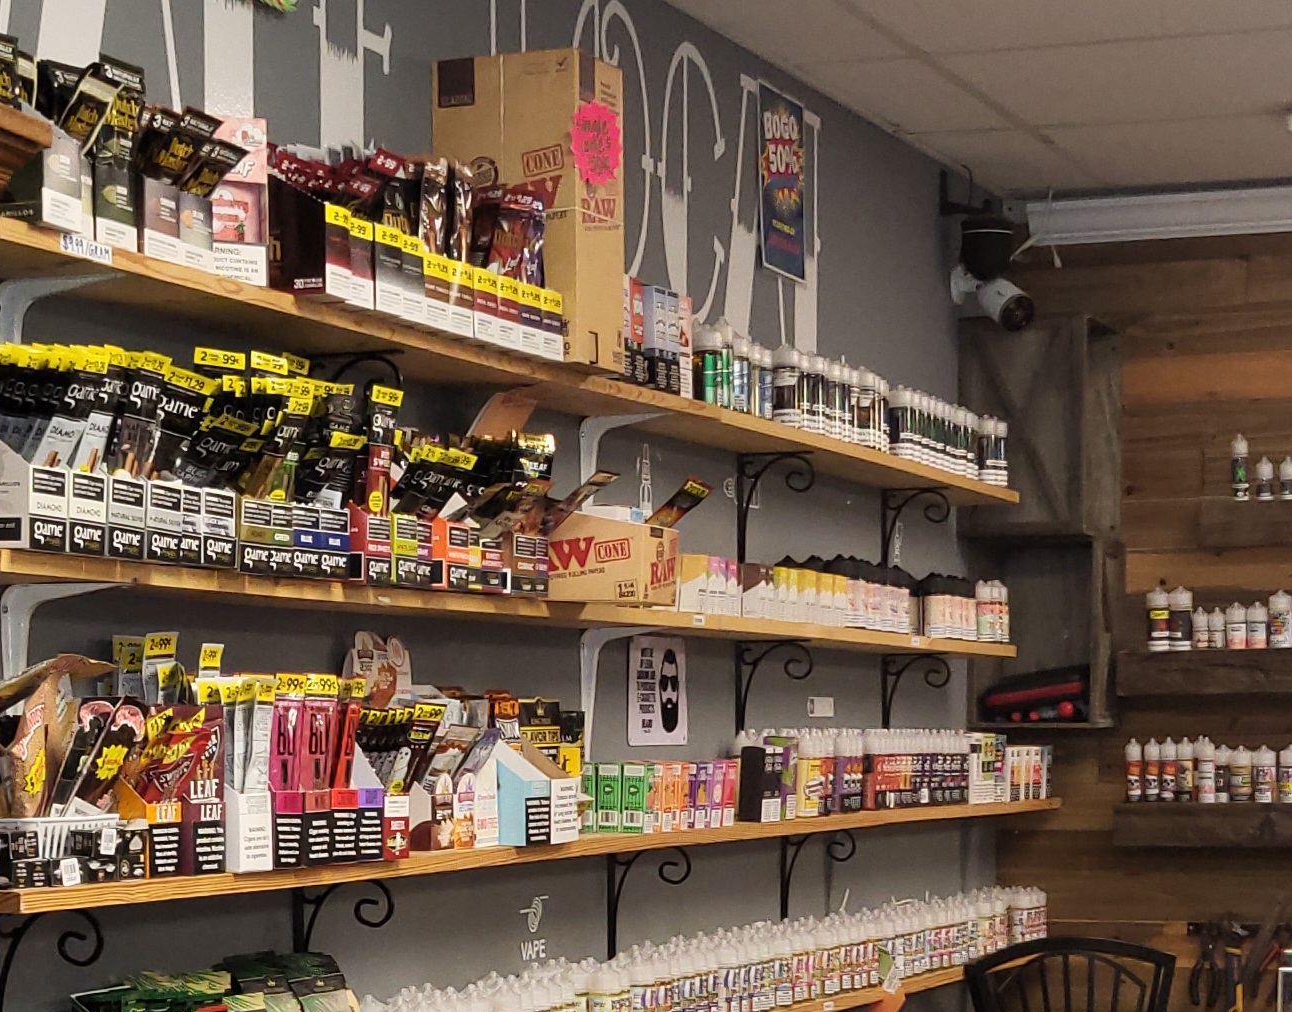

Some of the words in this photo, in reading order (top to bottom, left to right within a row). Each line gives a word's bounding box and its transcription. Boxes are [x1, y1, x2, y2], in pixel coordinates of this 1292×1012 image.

[763, 111, 799, 141] BOGO
[525, 152, 560, 173] CONE
[768, 144, 799, 174] 50%
[581, 198, 616, 224] RAW
[37, 501, 62, 513] DIAMOND
[76, 506, 101, 518] DIAMOND
[34, 521, 63, 545] game
[73, 525, 102, 549] game
[113, 530, 141, 553] game
[151, 534, 180, 556] game
[206, 539, 233, 561] game
[597, 541, 628, 560] CONE
[244, 547, 269, 570] game
[293, 551, 319, 573] game
[321, 554, 347, 575] game
[368, 560, 389, 581] game
[650, 557, 676, 584] RAW
[189, 779, 220, 799] LEAF
[156, 805, 178, 822] LEAF
[200, 804, 223, 822] LEAF
[520, 939, 546, 961] VAPE
